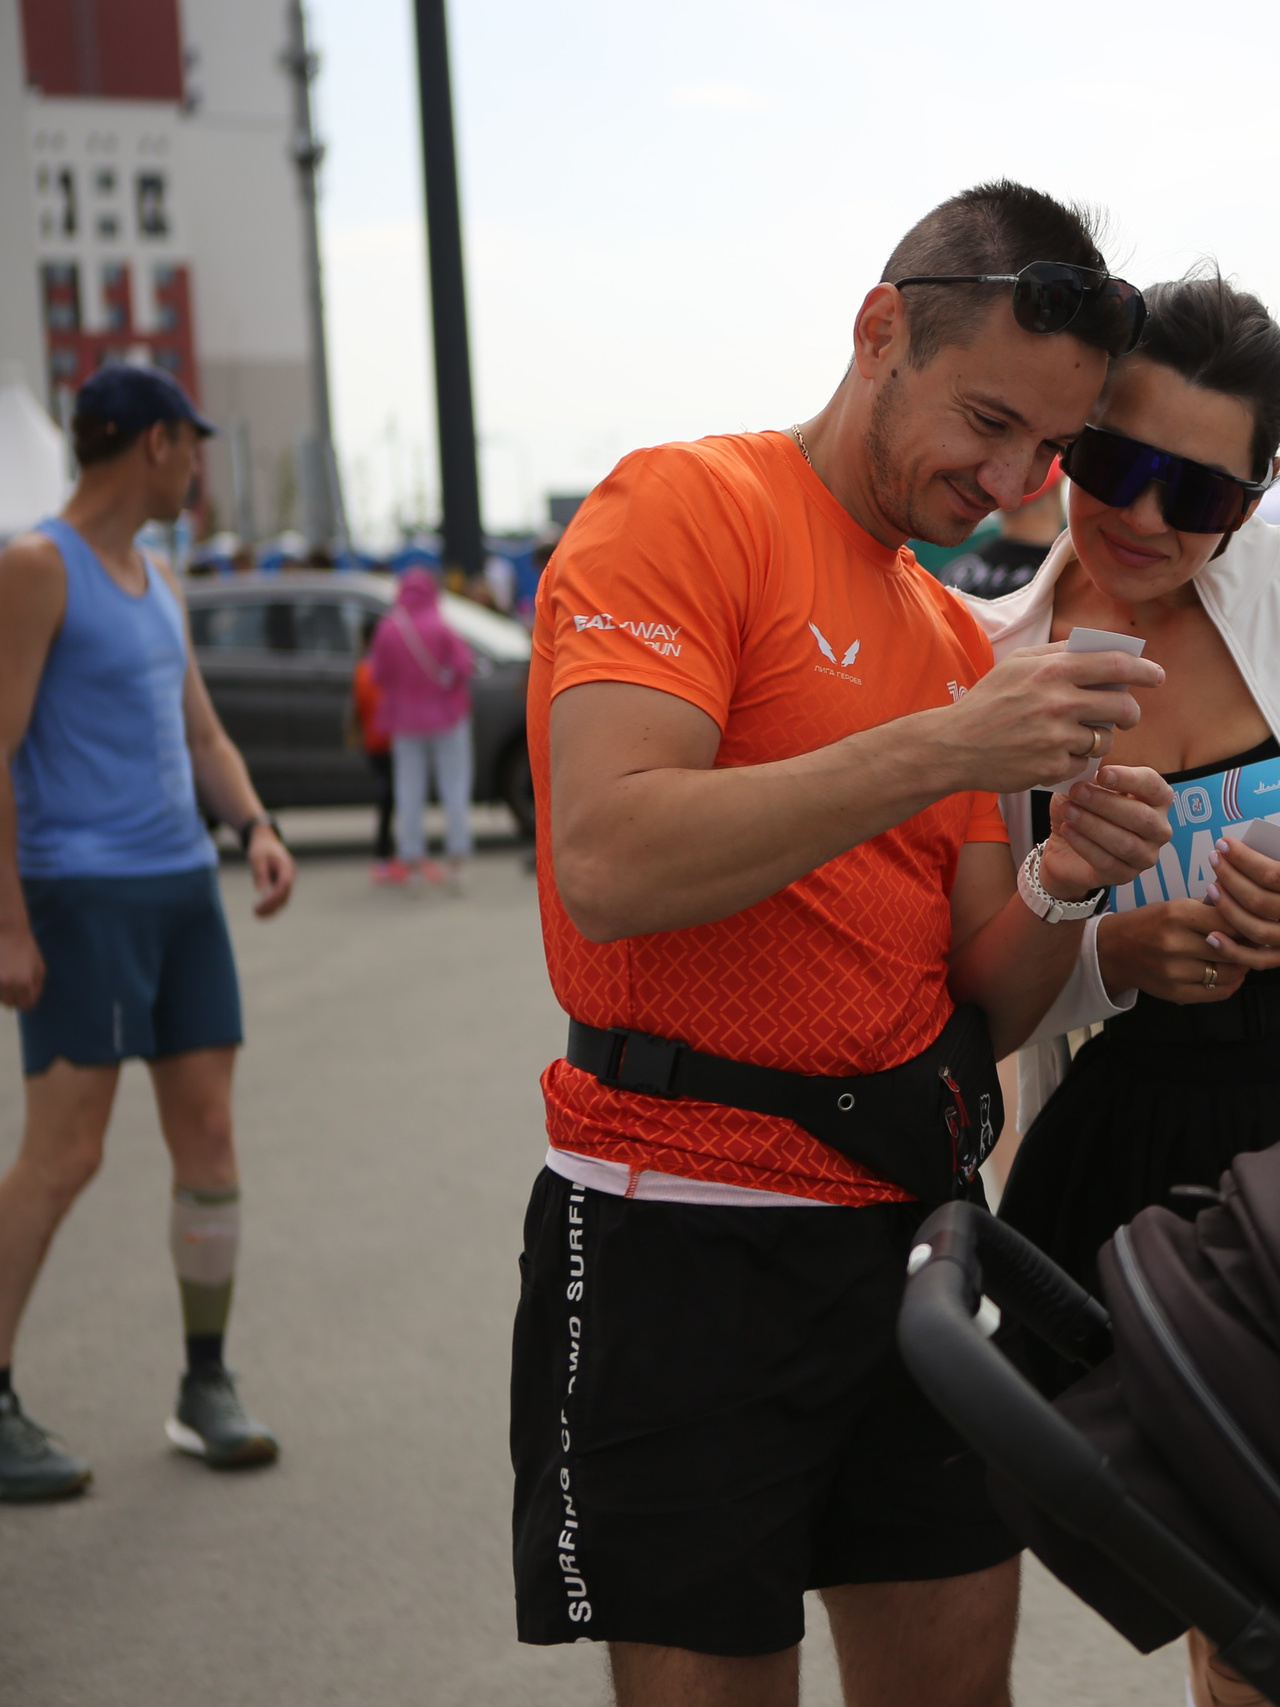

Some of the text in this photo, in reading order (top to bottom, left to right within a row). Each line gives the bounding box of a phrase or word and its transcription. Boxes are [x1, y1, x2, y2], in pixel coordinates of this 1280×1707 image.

[814, 665, 863, 686] ЛИГА ГЕРОЕВ
[557, 1467, 593, 1623] SURFING
